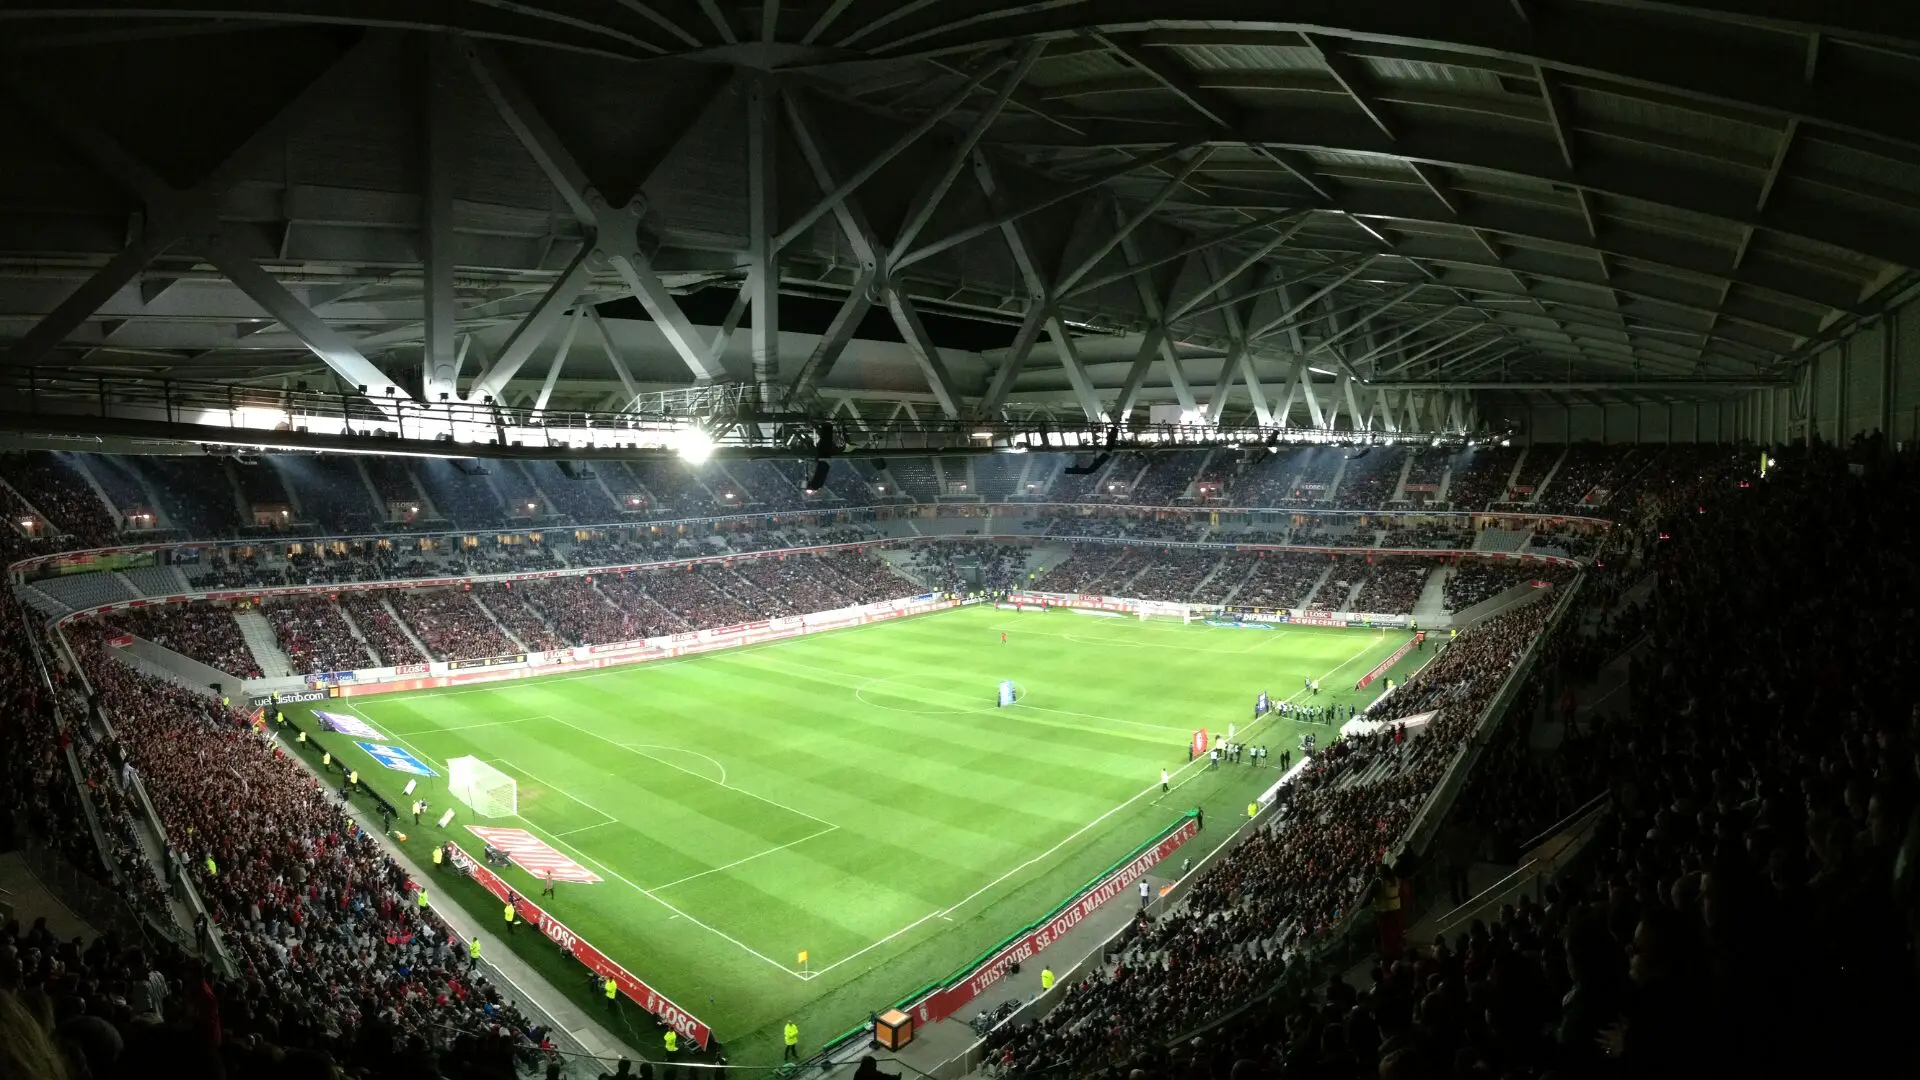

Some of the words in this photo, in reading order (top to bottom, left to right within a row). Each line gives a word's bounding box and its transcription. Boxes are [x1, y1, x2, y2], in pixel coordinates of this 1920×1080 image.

[403, 665, 426, 675] LOSC
[1035, 929, 1052, 953] SE
[1051, 909, 1083, 944] JOUE
[1083, 848, 1161, 916] MAINTENANT
[546, 920, 577, 953] LOSC
[657, 1001, 698, 1041] LOSC
